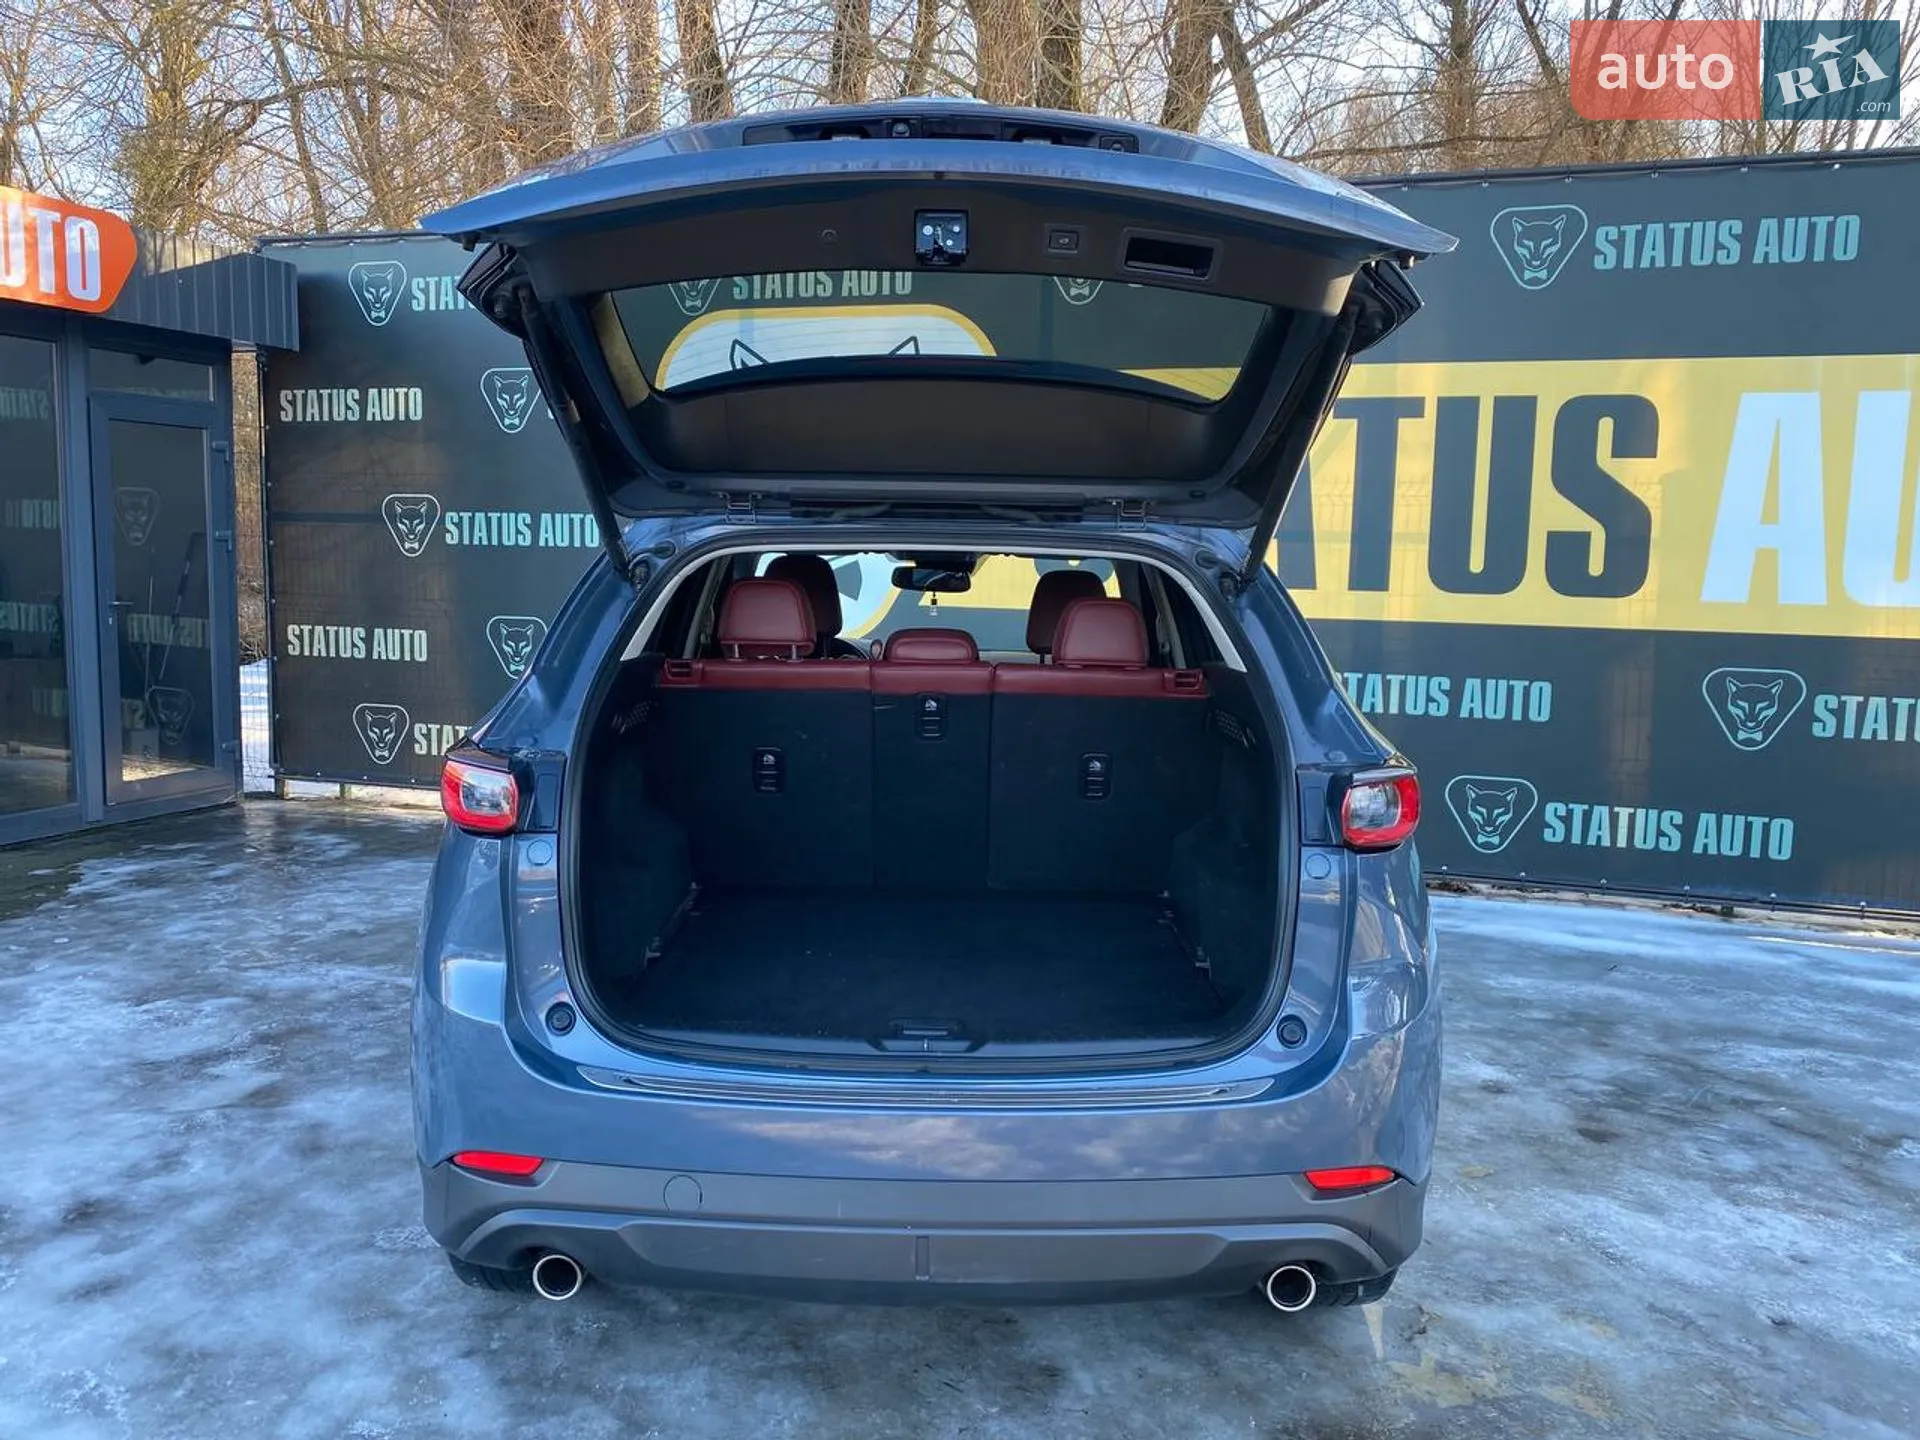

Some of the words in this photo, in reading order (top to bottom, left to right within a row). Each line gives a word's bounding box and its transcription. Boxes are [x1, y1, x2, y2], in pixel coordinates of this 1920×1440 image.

[1594, 219, 1743, 270] STATUS
[1752, 215, 1861, 264] AUTO
[842, 270, 913, 297] AUTO
[280, 388, 360, 422] STATUS
[366, 387, 423, 421] AUTO
[445, 511, 531, 546] STATUS
[539, 513, 600, 548] AUTO
[287, 624, 366, 659] STATUS
[372, 628, 428, 662] AUTO
[1336, 672, 1450, 717] TATUS
[1460, 677, 1552, 722] AUTO
[1812, 694, 1920, 742] STAT
[414, 723, 472, 756] STAT
[1544, 802, 1683, 852] STATUS
[1692, 812, 1794, 861] AUTO
